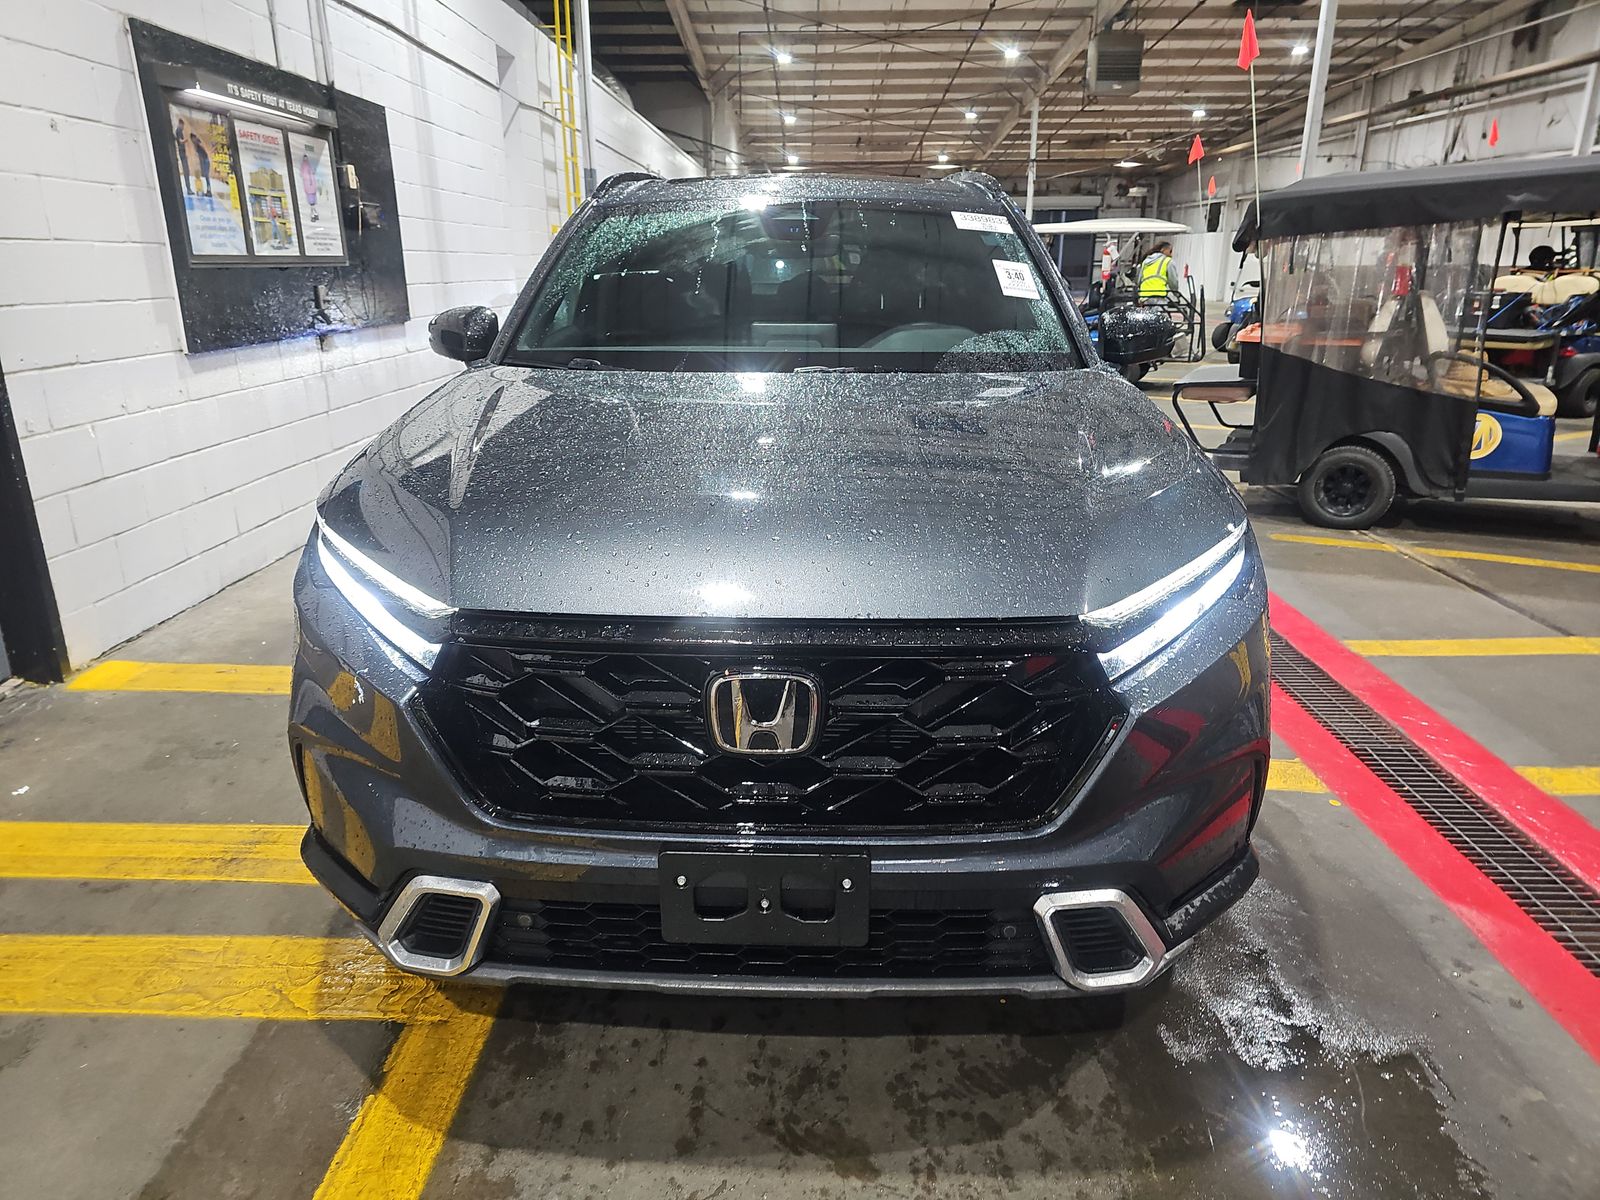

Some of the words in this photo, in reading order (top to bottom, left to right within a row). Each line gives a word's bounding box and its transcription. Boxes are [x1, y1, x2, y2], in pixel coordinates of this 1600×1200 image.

[240, 87, 261, 102] SAFETY
[262, 94, 277, 107] FIRST
[278, 99, 285, 109] AT
[286, 101, 302, 114] TEXAS
[239, 129, 261, 141] SAFETY
[1005, 271, 1025, 281] 3:40
